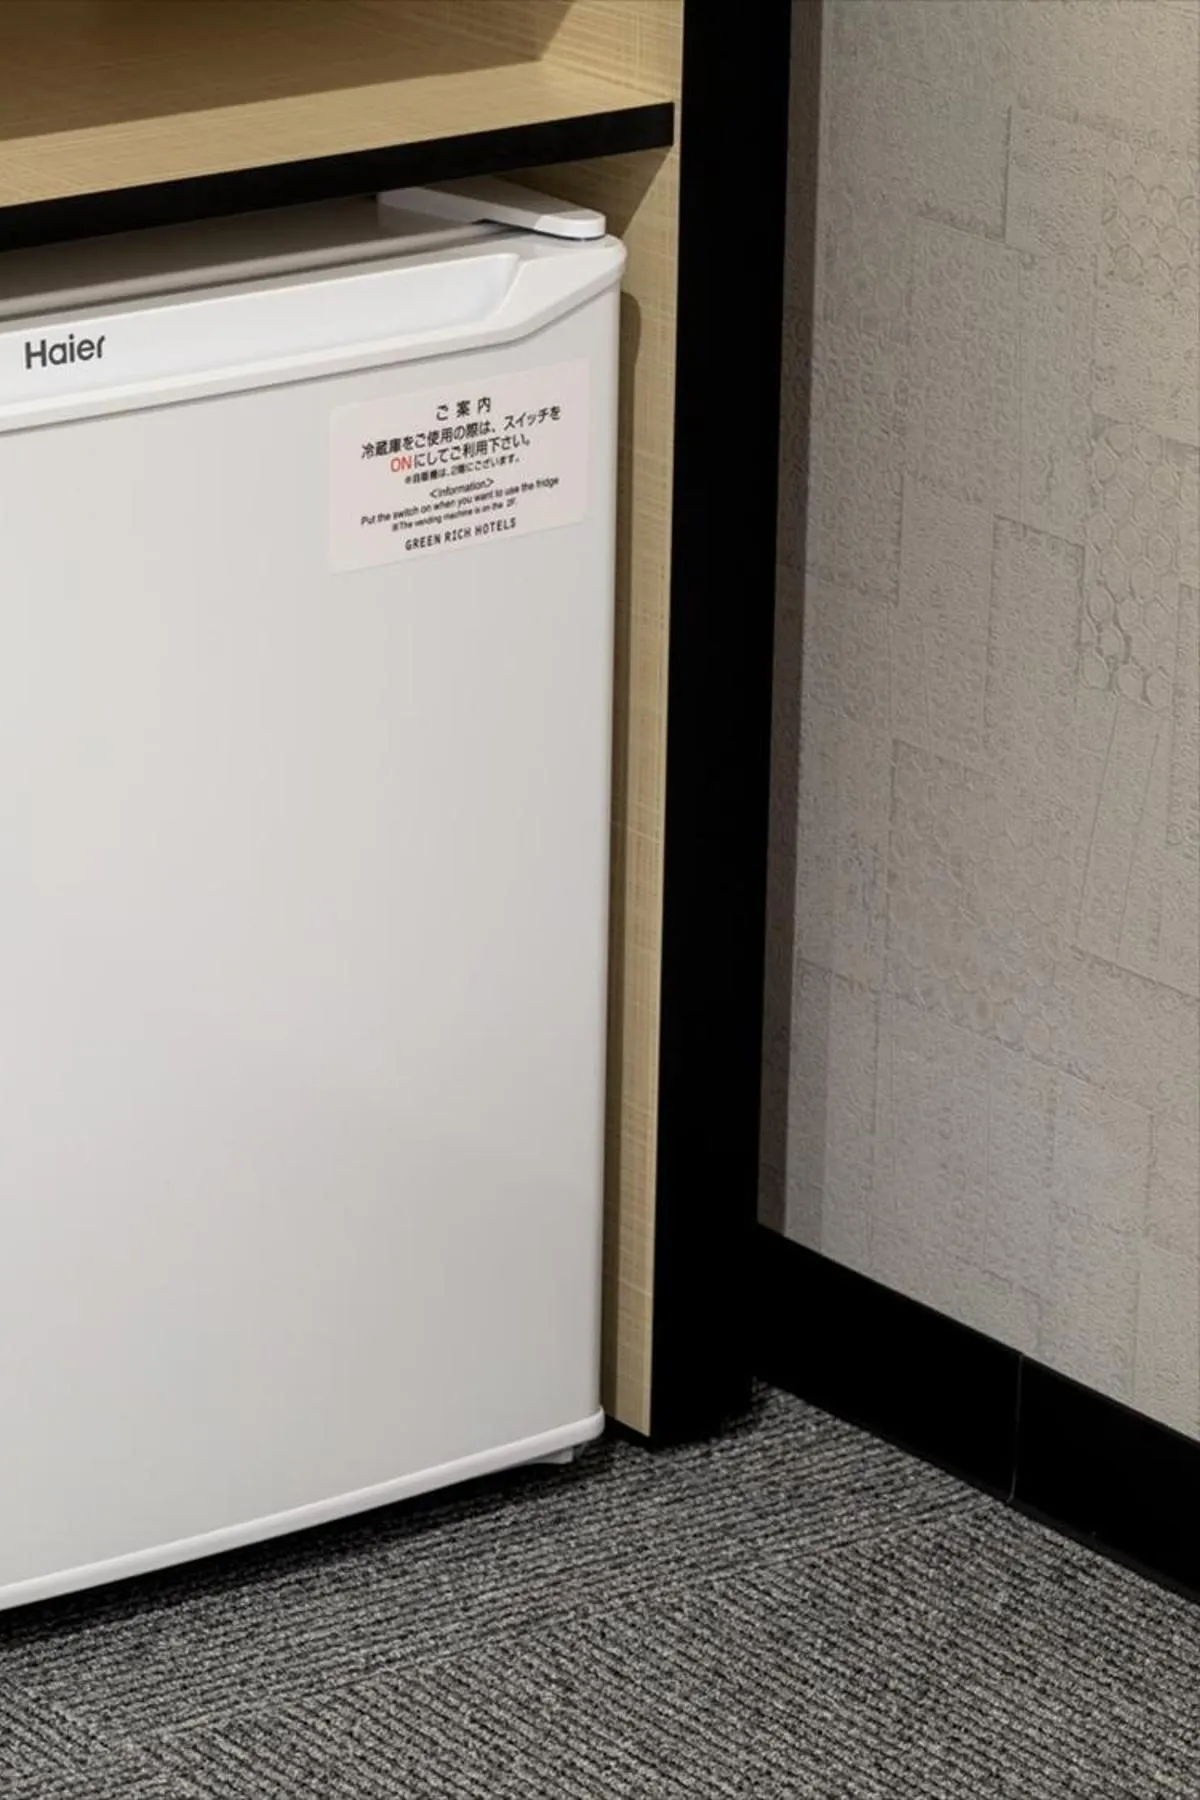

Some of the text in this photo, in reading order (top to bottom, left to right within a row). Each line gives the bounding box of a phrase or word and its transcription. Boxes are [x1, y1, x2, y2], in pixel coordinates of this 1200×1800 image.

[25, 333, 106, 370] Haier
[361, 477, 559, 525] Put the switch on when you want to use the fridge
[414, 515, 442, 526] vending
[443, 509, 472, 520] machine
[405, 516, 517, 550] GREEN RICH HOTELS
